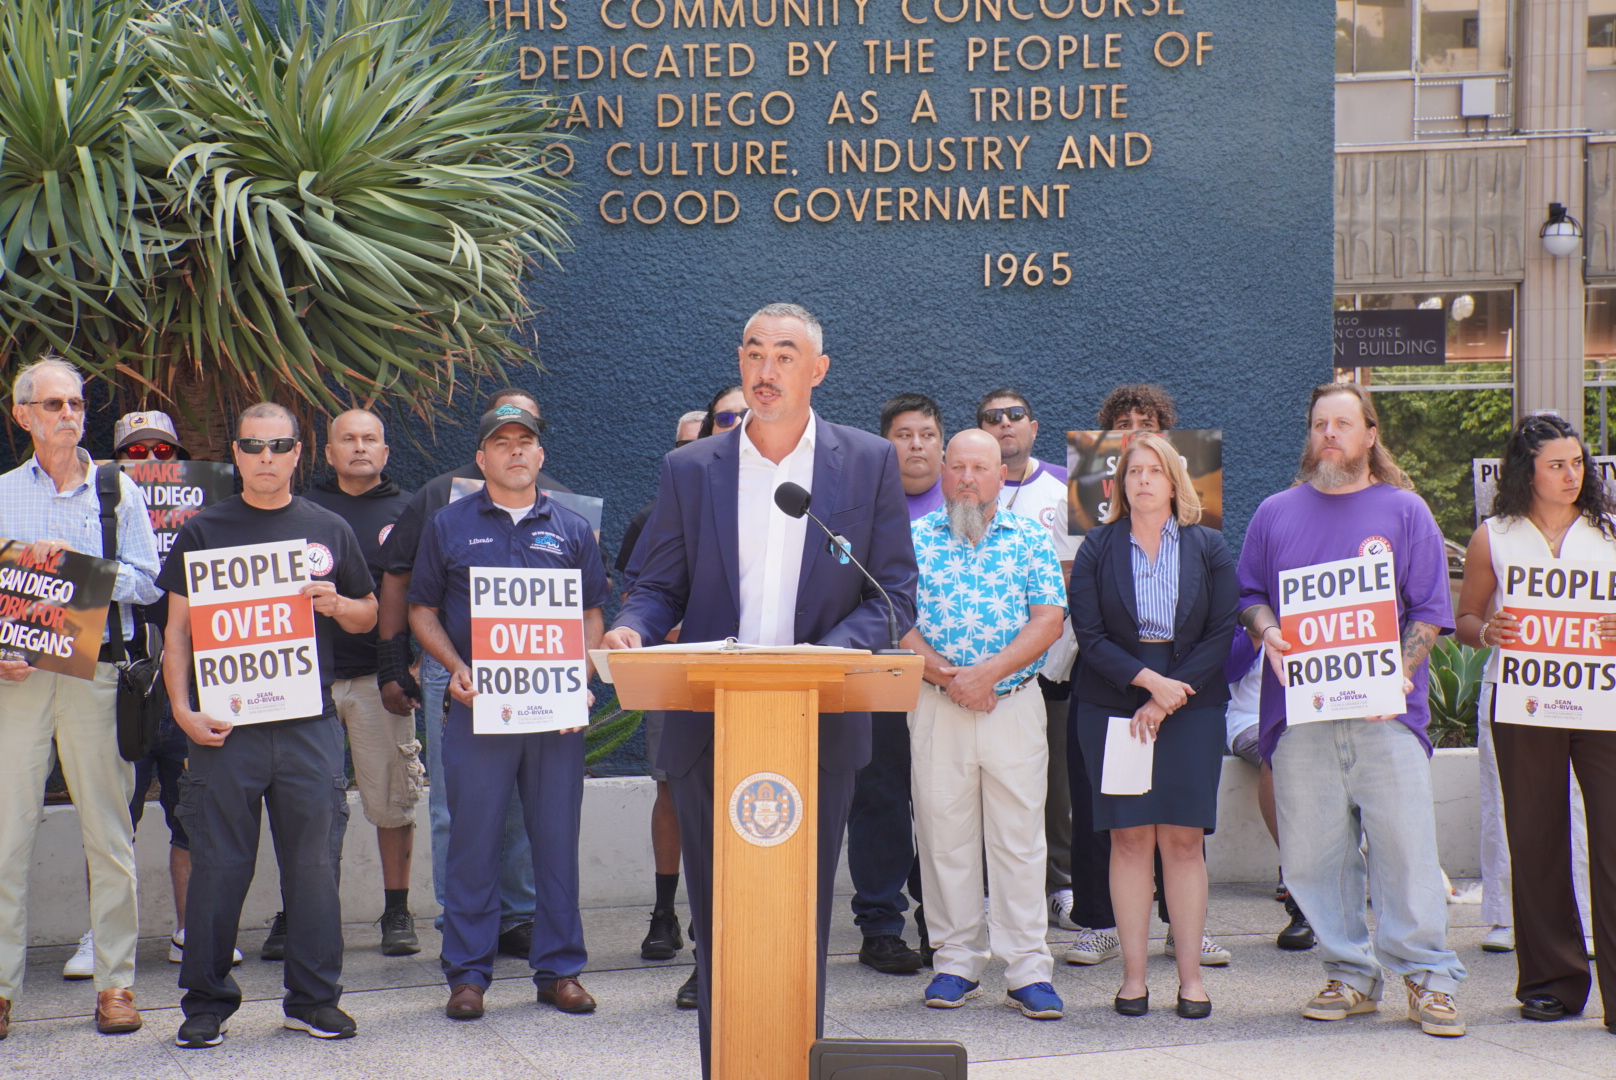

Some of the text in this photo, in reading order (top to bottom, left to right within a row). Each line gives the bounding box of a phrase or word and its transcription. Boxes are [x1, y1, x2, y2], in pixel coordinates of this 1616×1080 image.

[483, 0, 567, 30] THIS
[600, 0, 868, 29] COMMUNITY
[518, 43, 755, 80] DEDICATED
[787, 40, 837, 76] BY
[863, 38, 934, 74] THE
[967, 33, 1122, 71] PEOPLE
[1154, 31, 1214, 67] OF
[657, 91, 795, 127] DIEGO
[828, 90, 879, 124] AS
[911, 89, 938, 123] A
[969, 84, 1128, 121] TRIBUTE
[606, 140, 798, 176] CULTURE,
[826, 135, 1031, 173] INDUSTRY
[1057, 132, 1152, 170] AND
[599, 184, 1070, 225] GOOD GOVERNMENT
[983, 252, 1073, 287] 1965
[1334, 328, 1402, 339] NCOURSE
[1359, 340, 1437, 356] BUILDING
[134, 463, 183, 482] MAKE
[154, 486, 203, 506] DIEGO
[147, 509, 200, 529] RK FO
[0, 567, 74, 603] SAN DIEGO
[189, 550, 306, 593] PEOPLE
[1282, 562, 1390, 605] PEOPLE
[474, 577, 578, 607] PEOPLE
[0, 592, 67, 630] ORK FOR
[211, 602, 294, 642] OVER
[1299, 609, 1377, 646] OVER
[1, 621, 75, 658] DIEGANS
[490, 623, 565, 654] OVER
[1520, 614, 1602, 649] OVER
[200, 645, 313, 688] ROBOTS
[477, 666, 582, 695] ROBOTS
[1287, 648, 1397, 688] ROBOTS
[1502, 656, 1616, 691] ROBOTS
[247, 695, 285, 704] ELO-RIVERA
[1330, 694, 1367, 702] ELO-RIVERA
[1544, 703, 1583, 711] ELO-RIVERA
